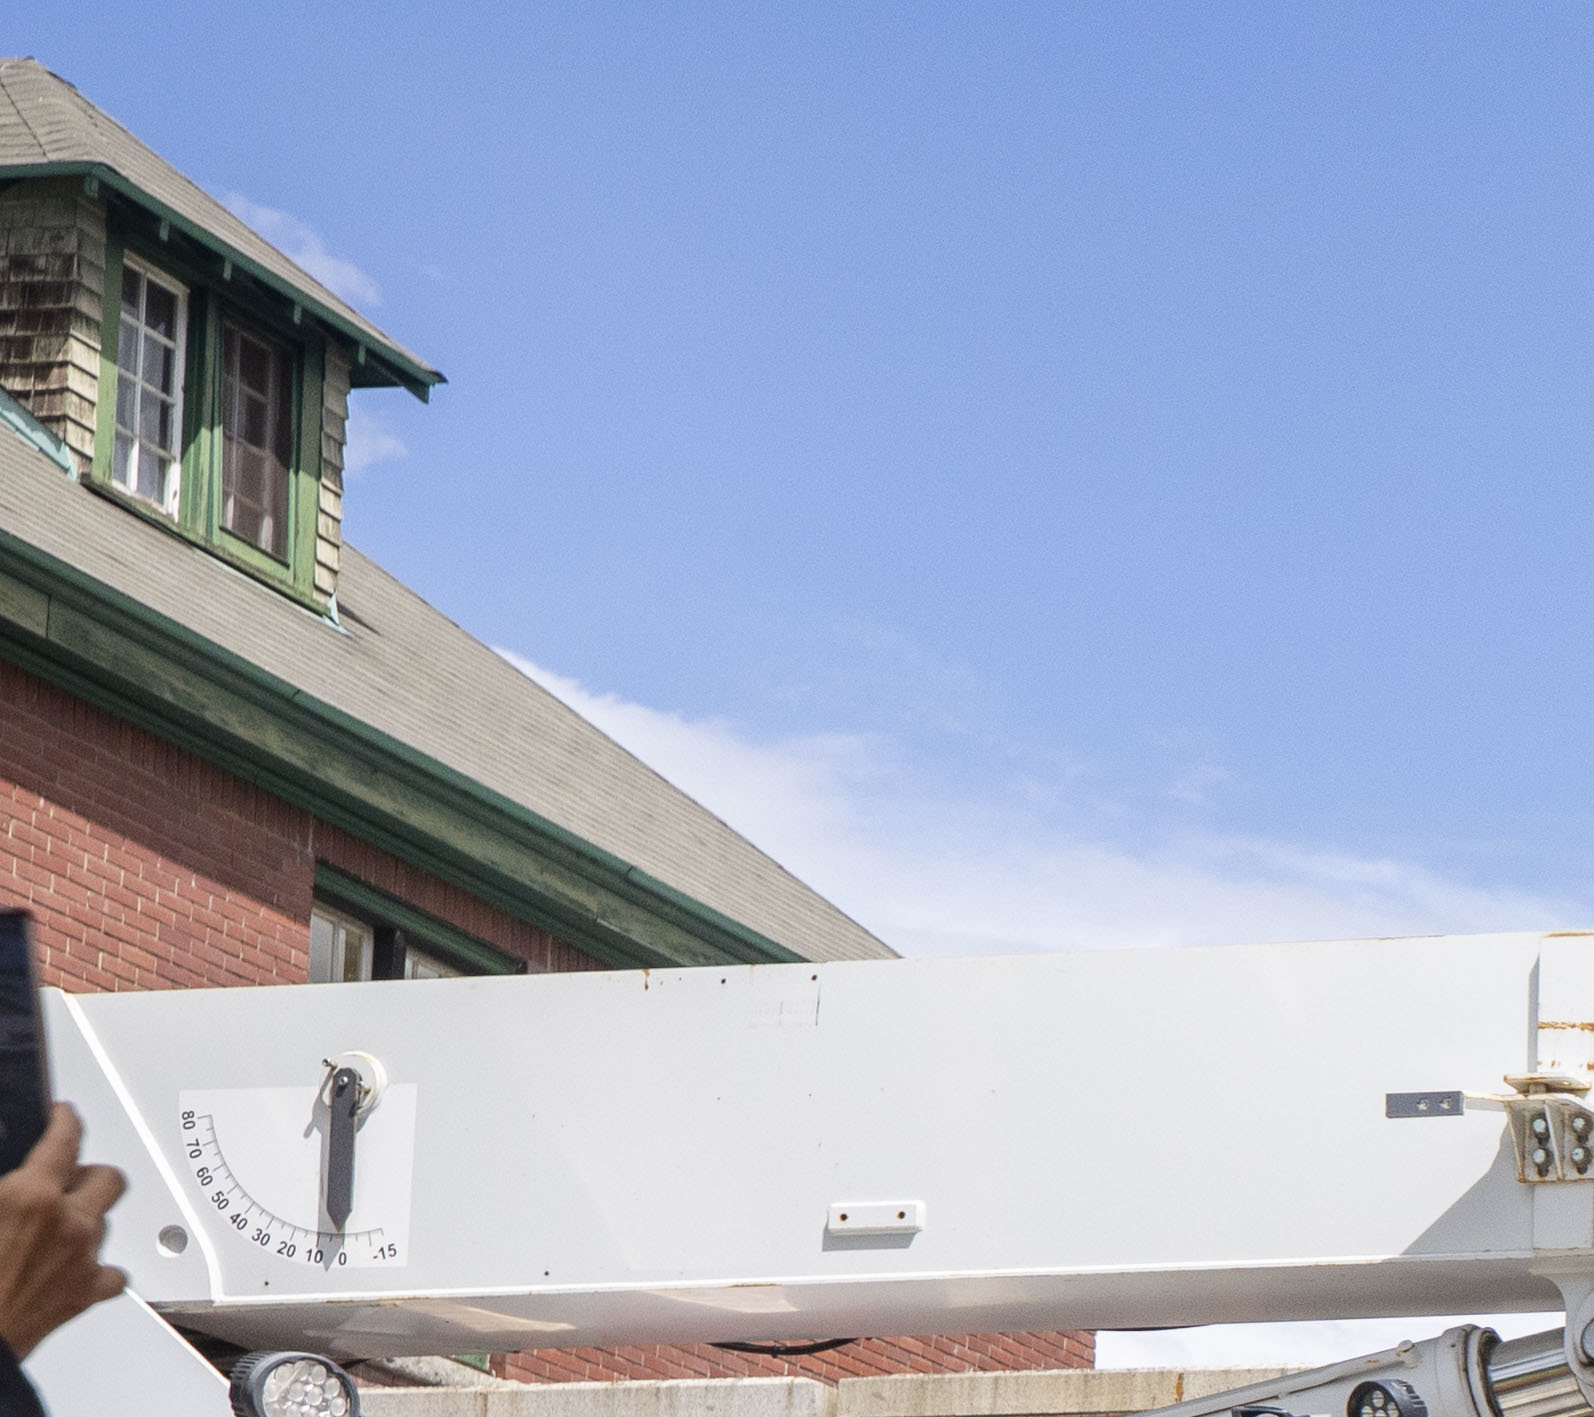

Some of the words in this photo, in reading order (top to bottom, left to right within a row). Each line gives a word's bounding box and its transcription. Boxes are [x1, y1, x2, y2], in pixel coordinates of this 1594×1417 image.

[181, 1109, 196, 1130] 80
[186, 1138, 202, 1159] 70
[196, 1166, 214, 1187] 60
[211, 1190, 230, 1210] 50
[229, 1212, 249, 1231] 40
[251, 1228, 271, 1247] 30
[276, 1240, 296, 1258] 20
[305, 1249, 323, 1264] 10
[372, 1243, 397, 1261] -15
[338, 1252, 347, 1266] 0
